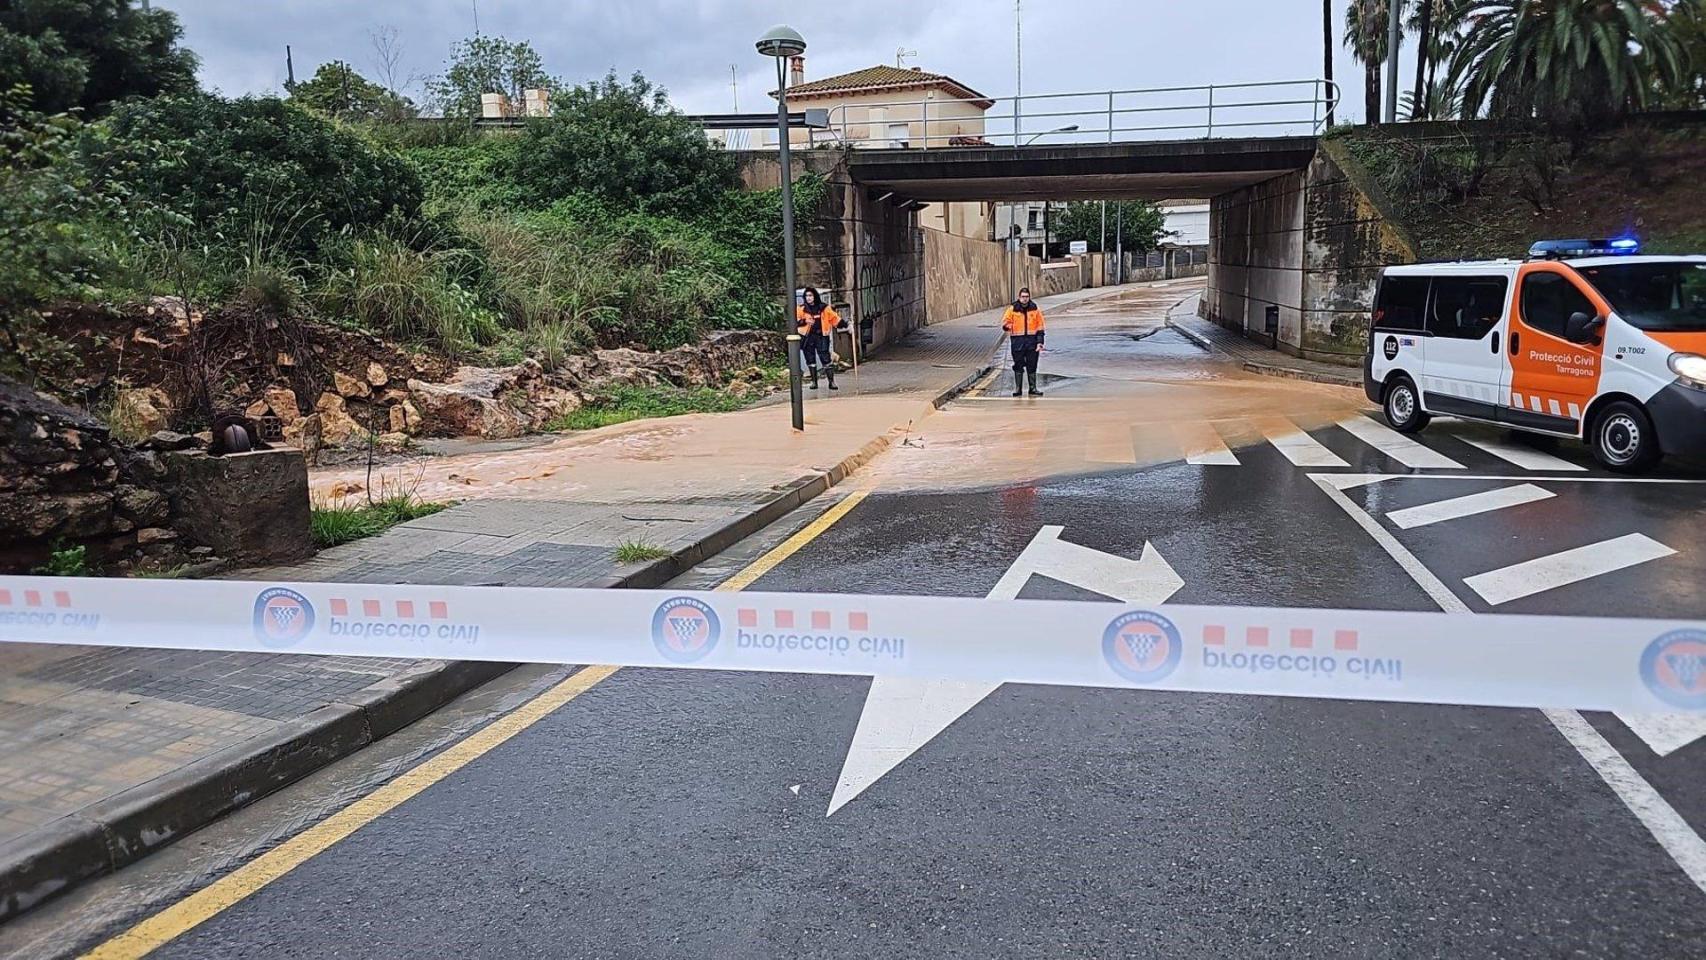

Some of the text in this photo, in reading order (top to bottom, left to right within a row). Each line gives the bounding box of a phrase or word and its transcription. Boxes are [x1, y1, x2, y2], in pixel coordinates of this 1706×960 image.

[1385, 341, 1397, 351] 112
[1617, 346, 1646, 355] 09.T002
[1529, 350, 1595, 366] Protecció Civil
[1555, 364, 1595, 377] Tarragona
